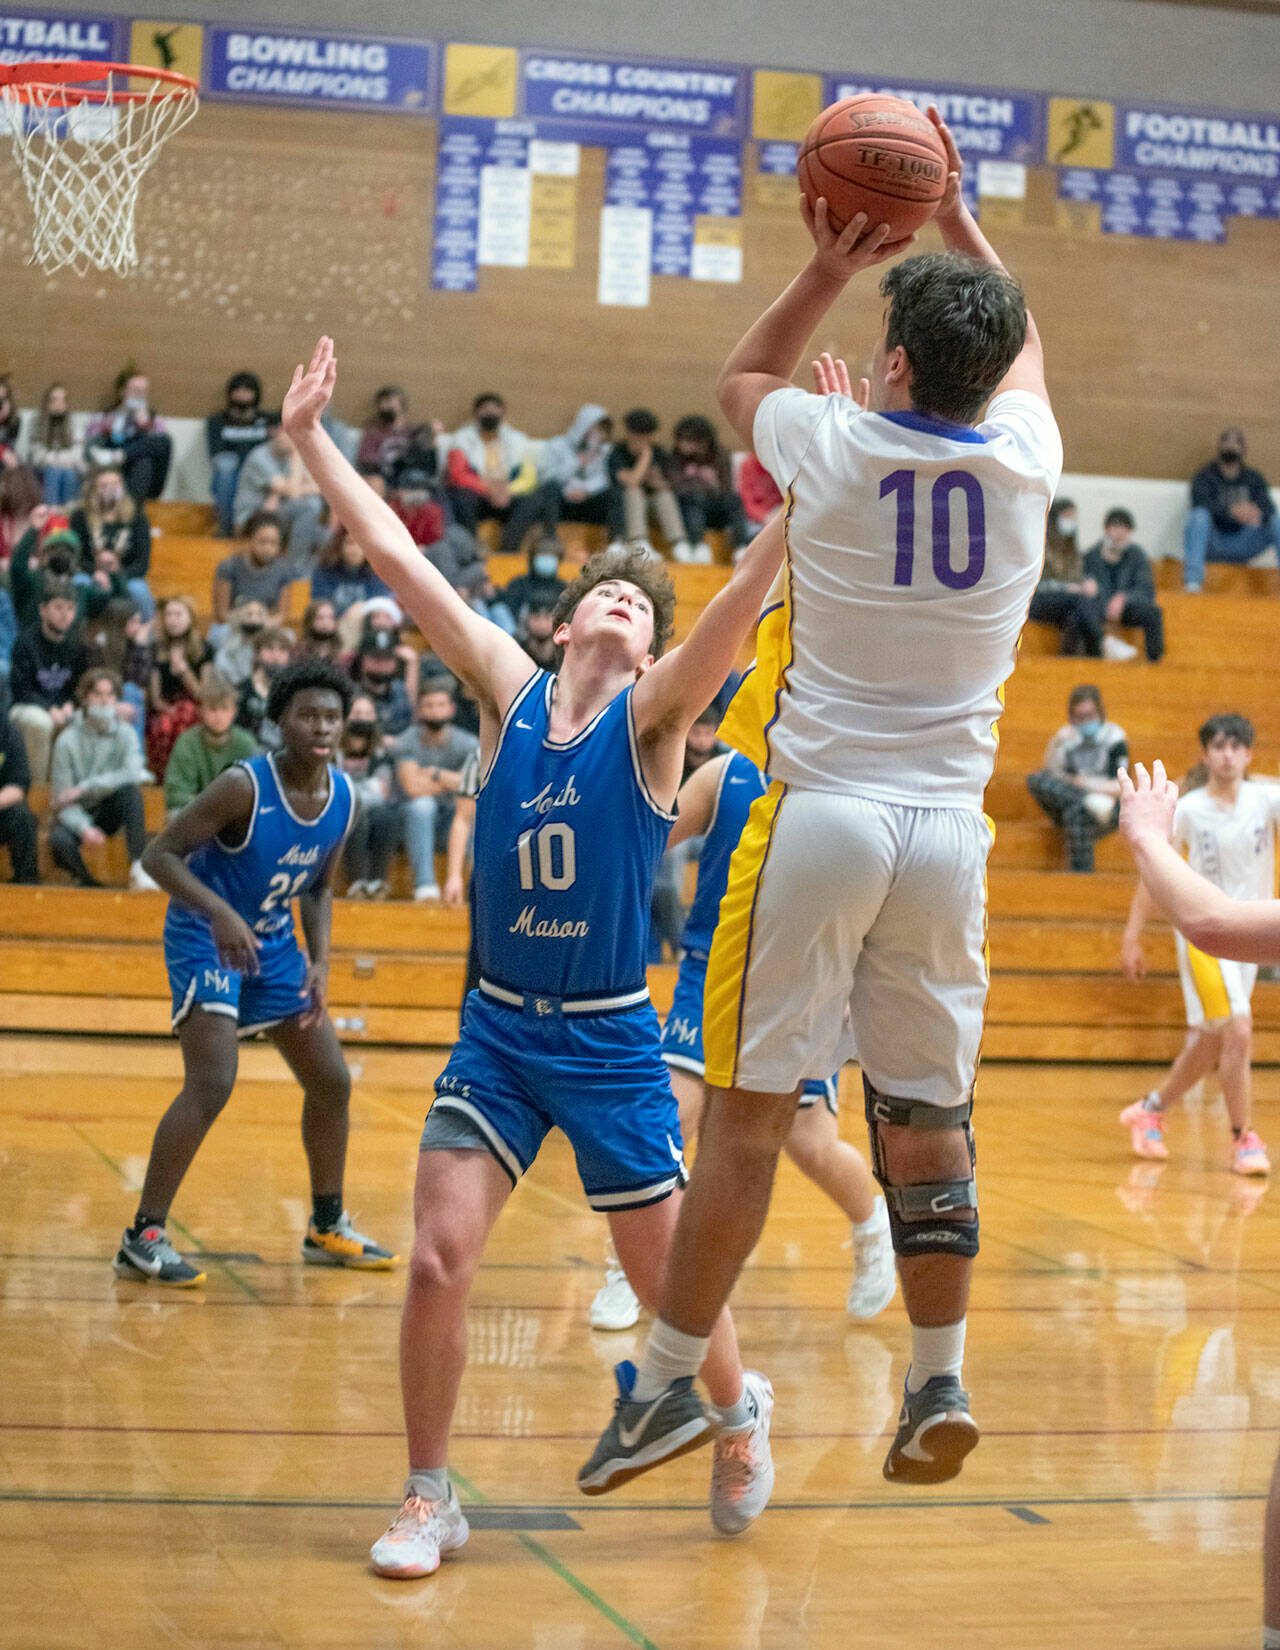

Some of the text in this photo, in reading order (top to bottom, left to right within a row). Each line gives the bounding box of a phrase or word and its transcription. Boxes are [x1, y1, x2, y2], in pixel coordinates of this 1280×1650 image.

[0, 17, 109, 50] TBALL
[226, 34, 388, 72] BOWLING
[226, 65, 389, 100] CHAMPIONS
[525, 59, 737, 96] CROSS COUNTRY
[552, 88, 710, 123] CHAMPIONS
[857, 149, 943, 180] TF-1000
[1134, 141, 1279, 178] CHAMPIONS
[879, 469, 986, 590] 10
[277, 844, 320, 865] North
[517, 822, 577, 891] 10
[509, 905, 590, 938] Mason
[204, 968, 230, 994] NM
[673, 1018, 699, 1045] NM
